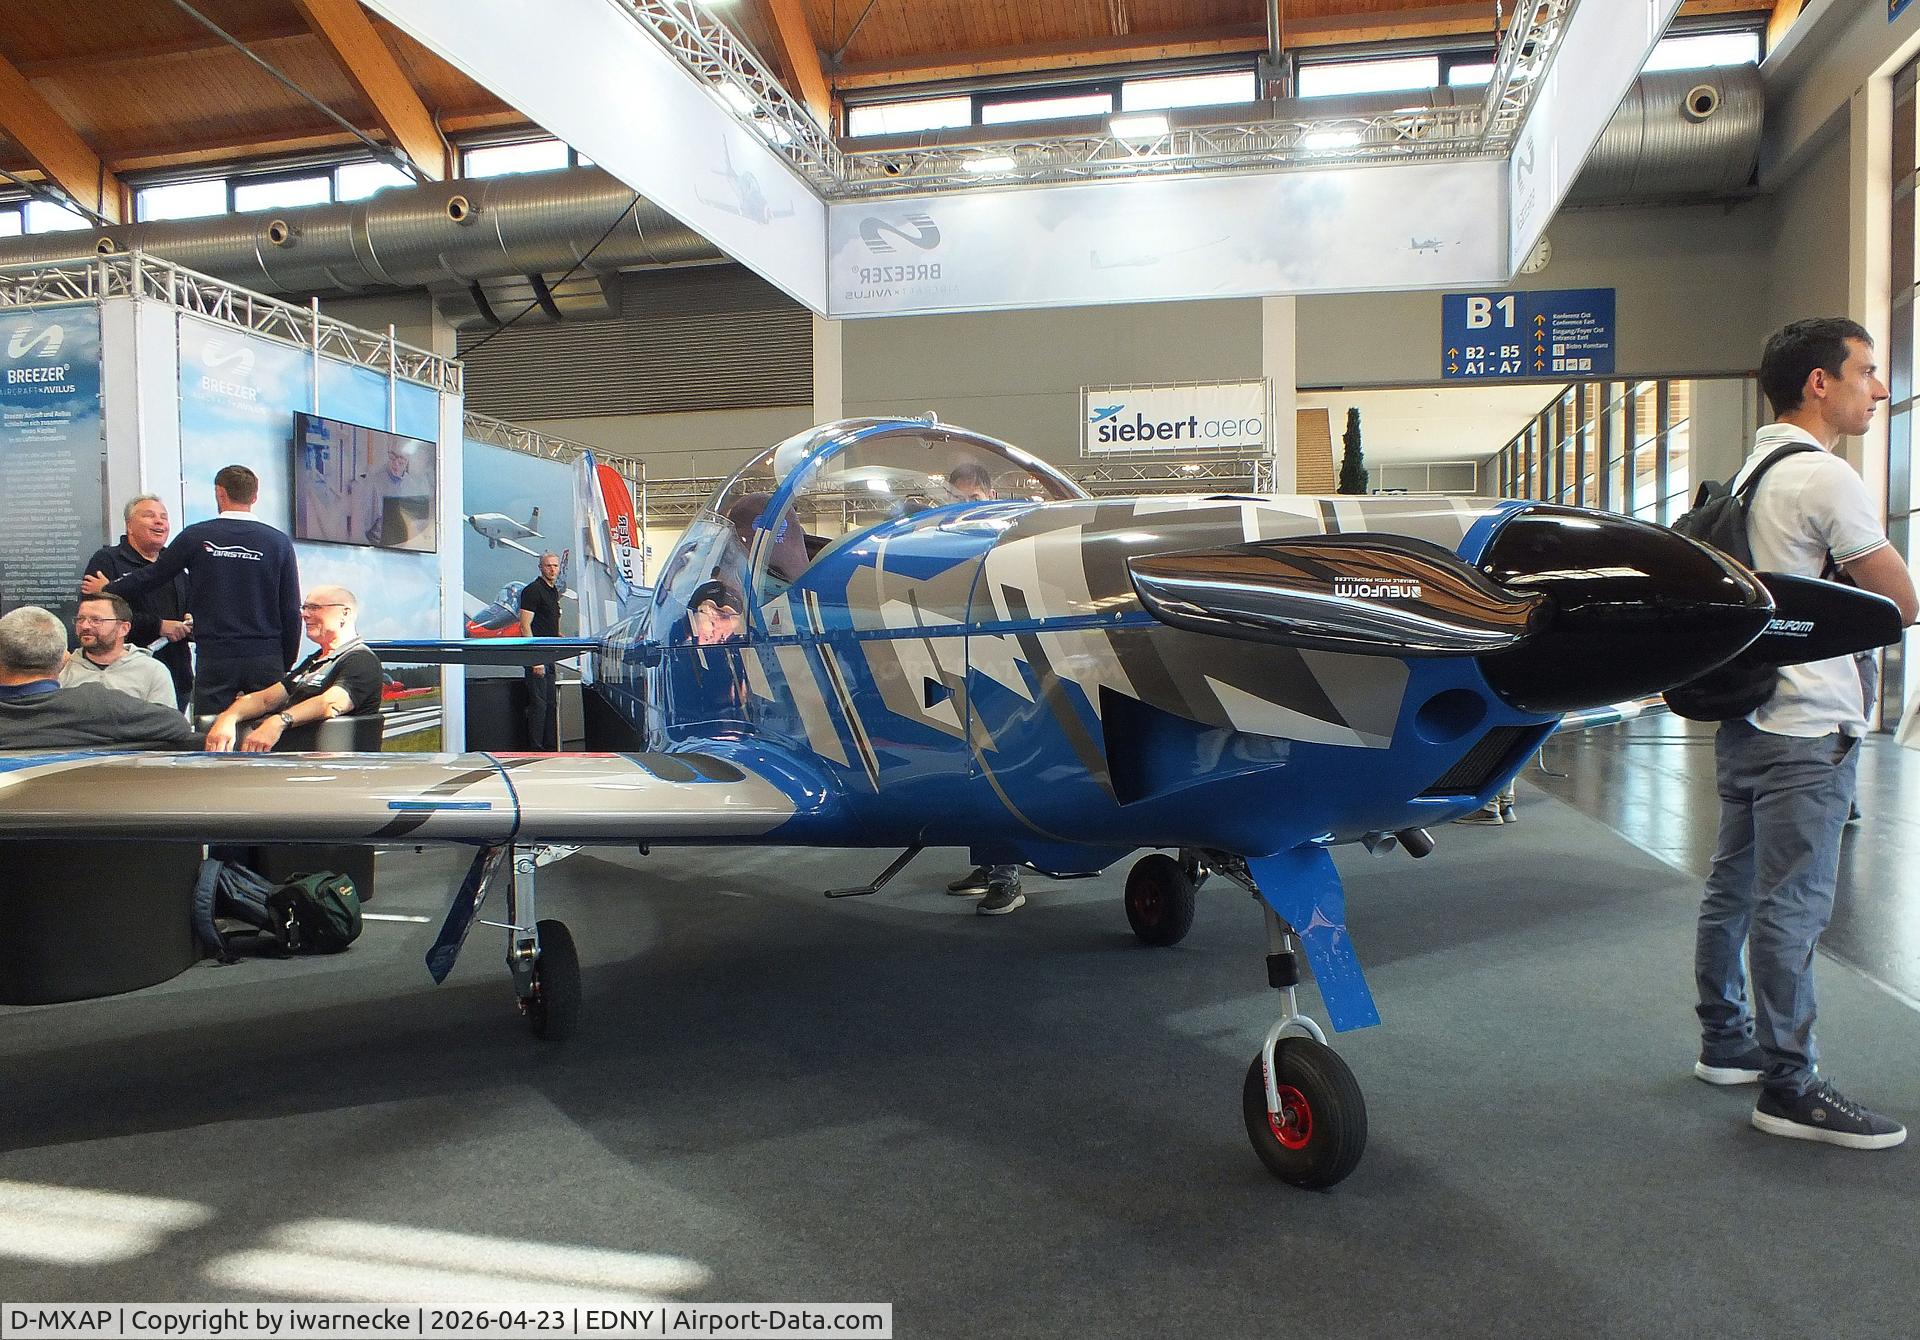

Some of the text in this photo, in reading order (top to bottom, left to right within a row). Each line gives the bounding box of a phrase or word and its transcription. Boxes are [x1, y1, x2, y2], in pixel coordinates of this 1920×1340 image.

[1466, 295, 1515, 330] B1
[1465, 346, 1485, 360] B2
[1500, 345, 1520, 358] B5
[1464, 361, 1484, 375] A1
[1499, 360, 1521, 374] A7
[1098, 413, 1263, 443] siebert.aero
